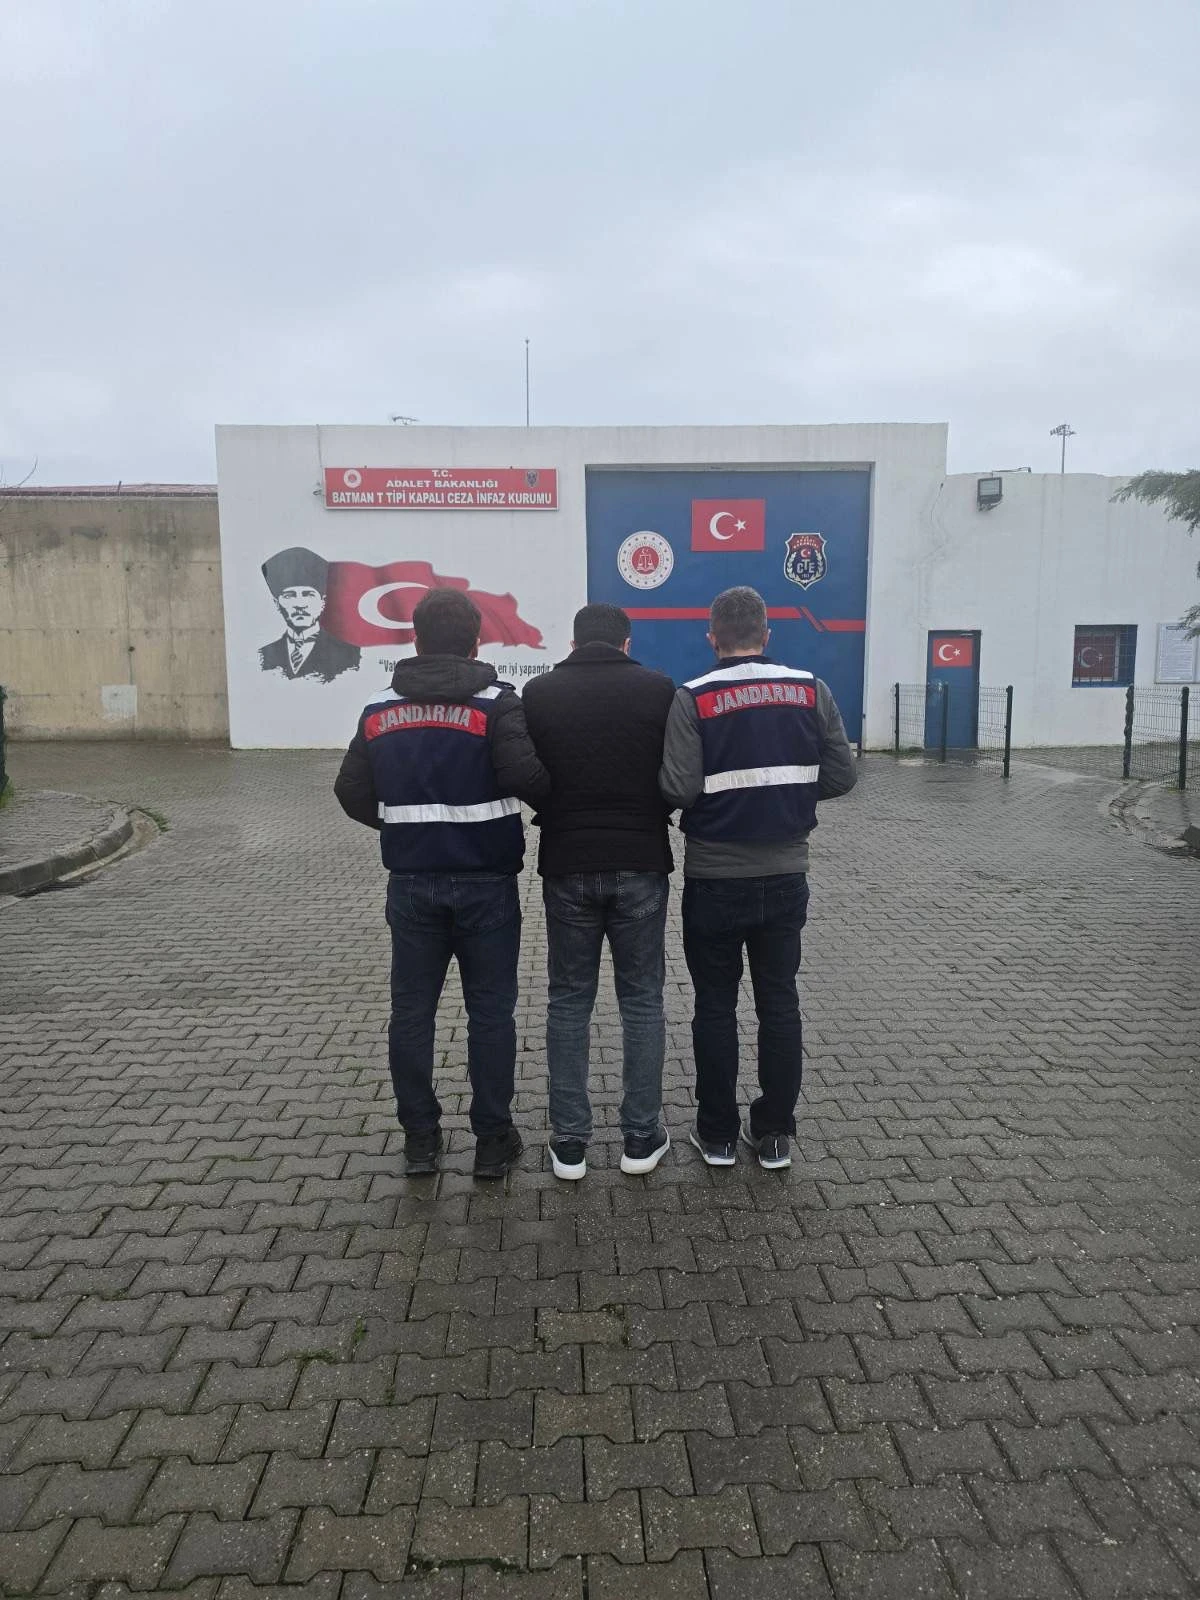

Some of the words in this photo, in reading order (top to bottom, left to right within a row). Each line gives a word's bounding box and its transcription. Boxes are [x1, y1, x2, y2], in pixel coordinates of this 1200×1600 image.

[432, 469, 453, 478] T.C.
[386, 480, 431, 488] ADALET
[435, 479, 498, 489] BAKANLIĞI
[332, 492, 374, 504] BATMAN
[377, 492, 383, 504] T
[387, 490, 406, 504] TİPİ
[409, 492, 445, 504] KAPALI
[447, 492, 474, 504] CEZA
[476, 490, 506, 505] İNFAZ
[508, 492, 552, 505] KURUMU
[498, 664, 507, 674] en
[713, 684, 808, 714] JANDARMA
[378, 704, 472, 732] JANDARMA
